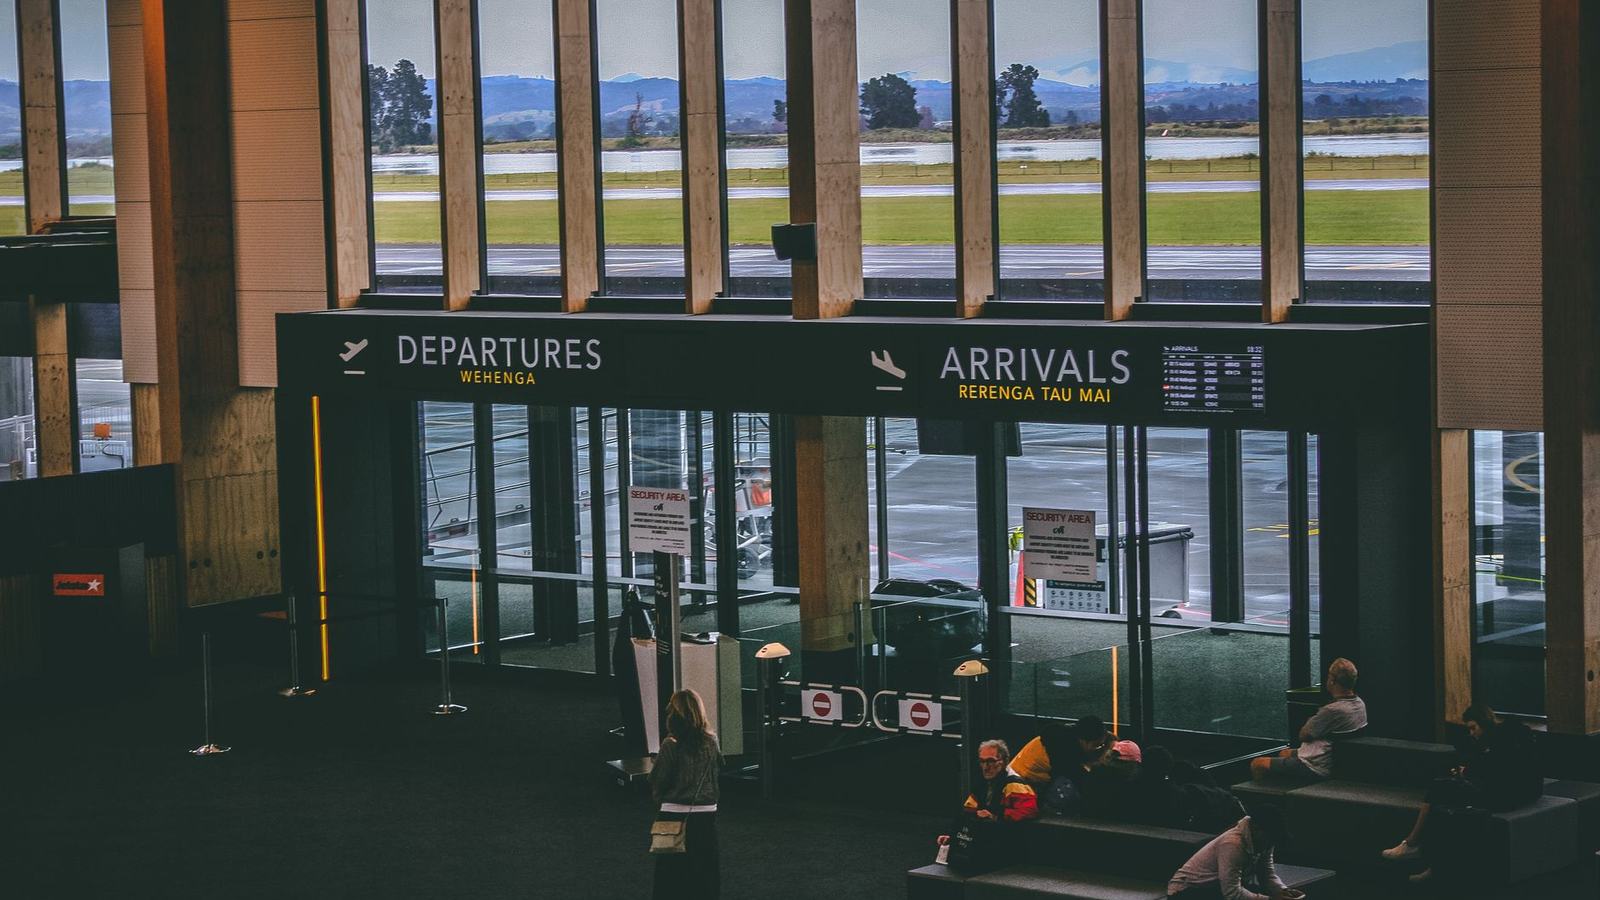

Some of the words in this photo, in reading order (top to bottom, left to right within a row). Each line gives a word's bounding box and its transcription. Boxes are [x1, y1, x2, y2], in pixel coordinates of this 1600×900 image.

[398, 335, 601, 370] DEPARTURES
[940, 346, 1131, 384] ARRIVALS
[460, 370, 536, 385] WEHENGA
[959, 384, 1035, 401] RERENGA
[1041, 386, 1073, 402] TAU
[1079, 388, 1111, 403] MAI
[631, 491, 665, 500] SECURITY
[666, 492, 686, 502] AREA
[1026, 512, 1066, 523] SECURITY
[1067, 514, 1091, 524] AREA
